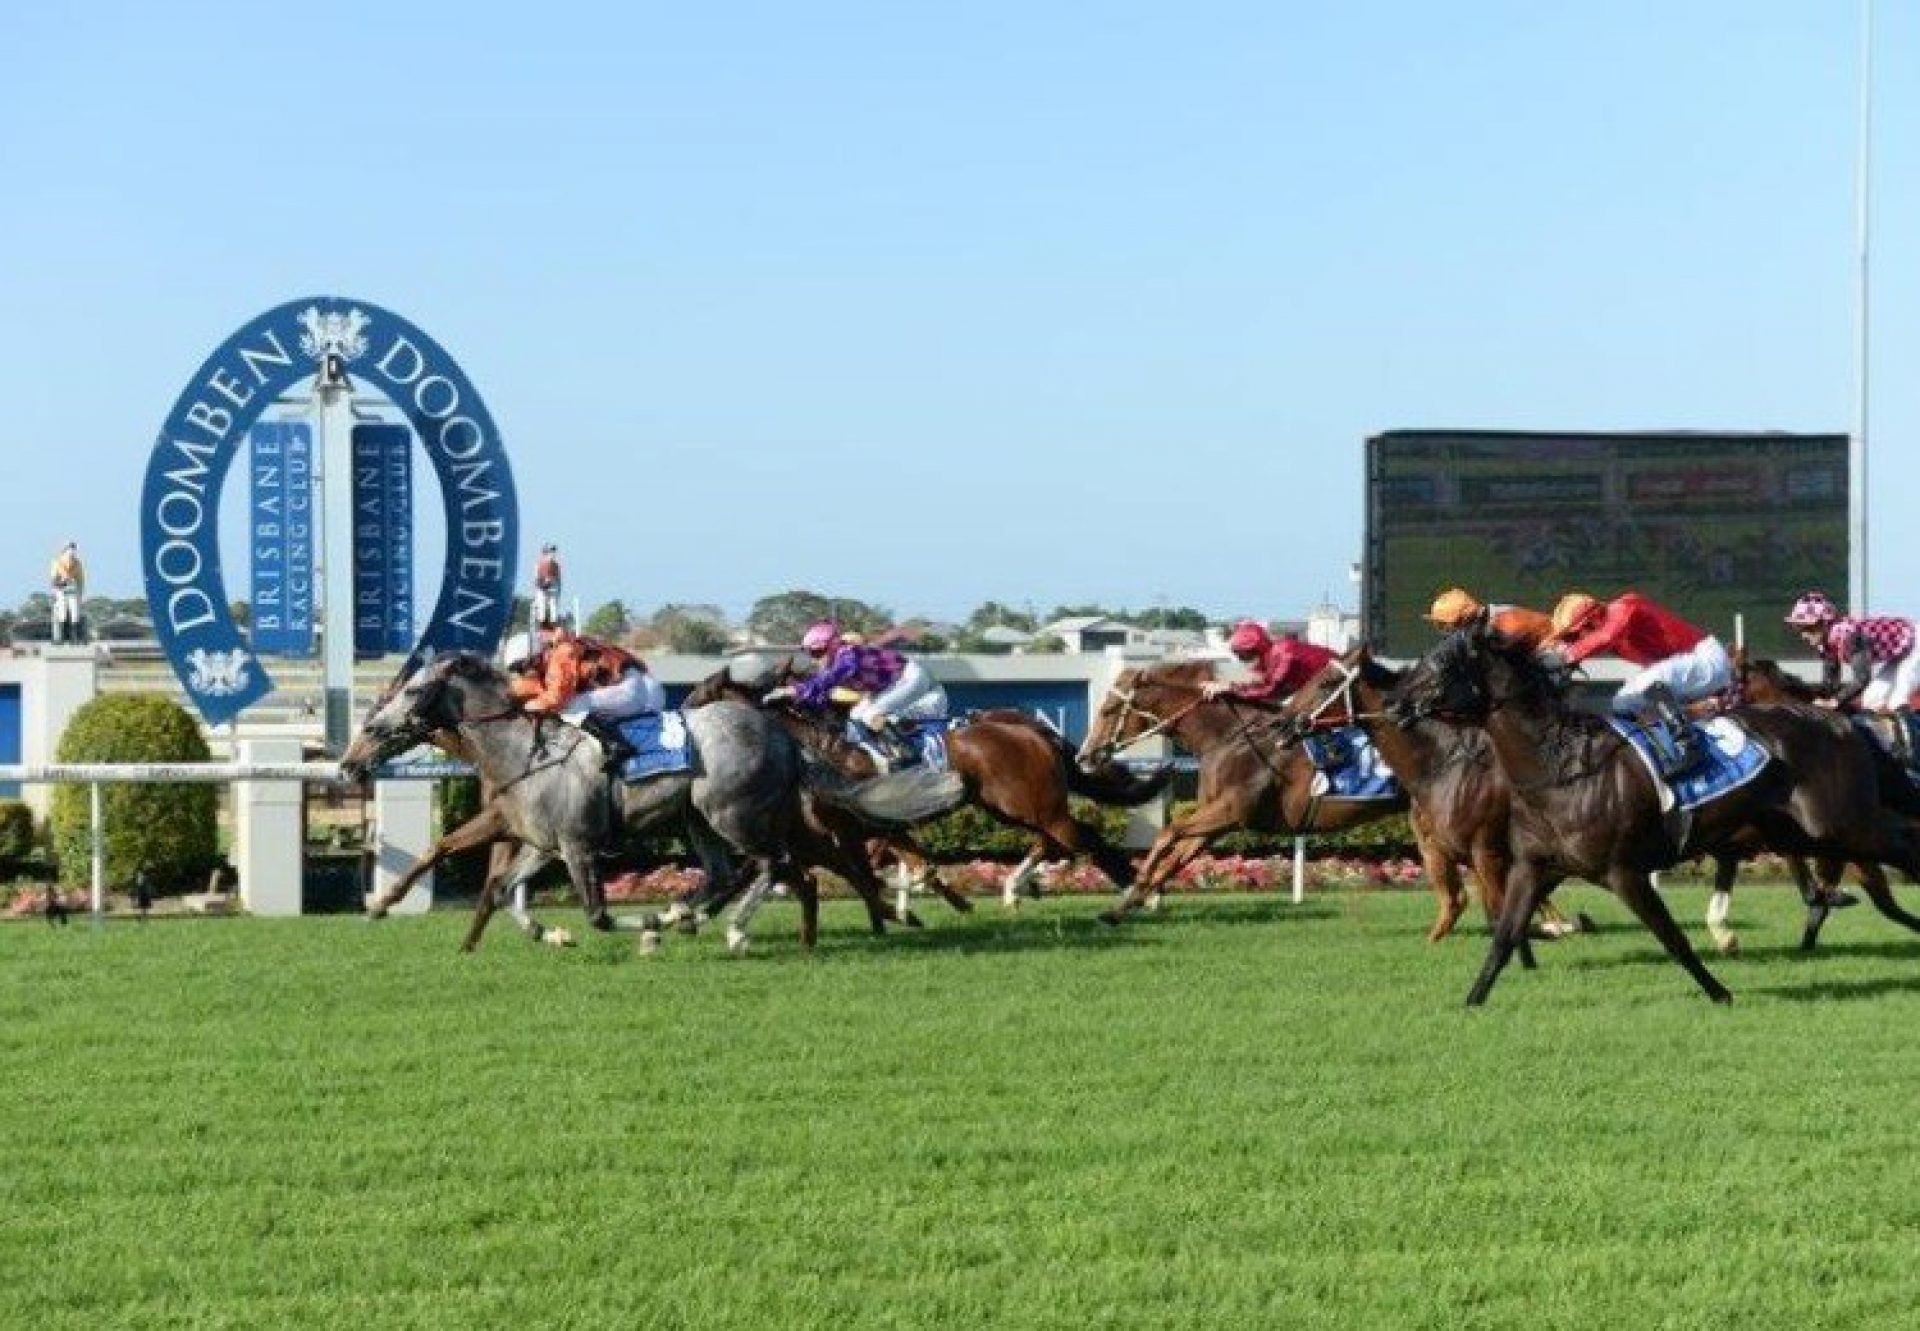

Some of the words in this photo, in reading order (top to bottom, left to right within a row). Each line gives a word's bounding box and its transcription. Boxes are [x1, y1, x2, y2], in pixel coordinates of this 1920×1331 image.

[156, 330, 293, 636] DOOMBEN
[255, 442, 281, 631] BRISBANE
[290, 522, 308, 631] RACING
[356, 443, 382, 629] BRISBANE
[375, 335, 504, 637] DOOMBEN
